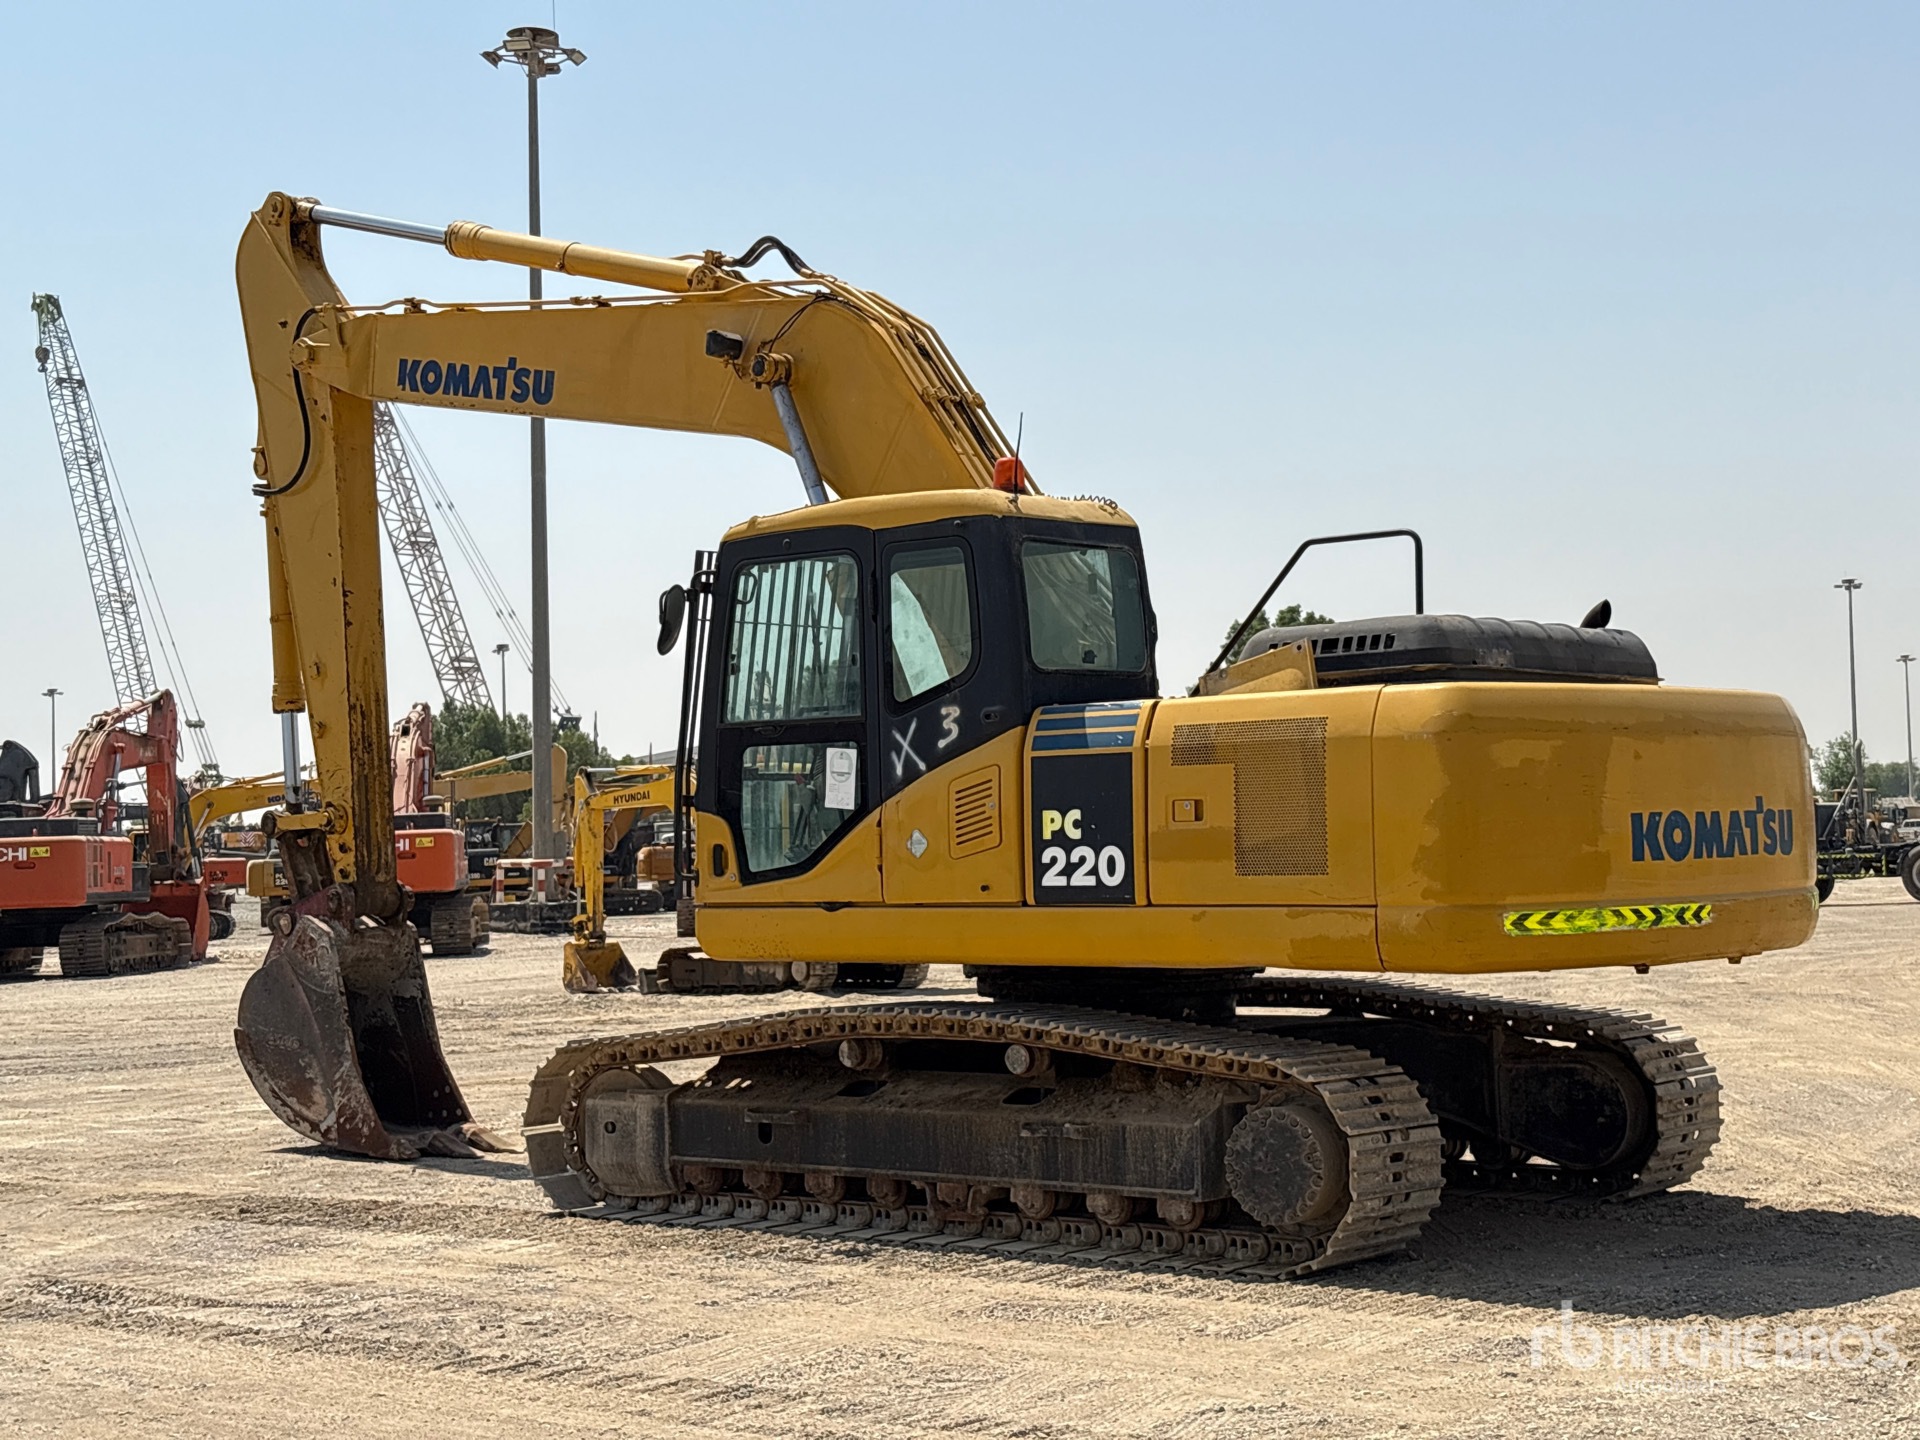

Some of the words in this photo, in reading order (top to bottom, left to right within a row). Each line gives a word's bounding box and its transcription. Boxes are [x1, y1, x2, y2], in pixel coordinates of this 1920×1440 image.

[397, 356, 555, 405] KOMATSU
[937, 706, 960, 749] 3
[613, 790, 650, 805] HYUNDAI
[1042, 808, 1082, 840] PC
[1630, 795, 1793, 862] KOMATSU
[483, 857, 498, 867] CAT
[1041, 845, 1126, 887] 220
